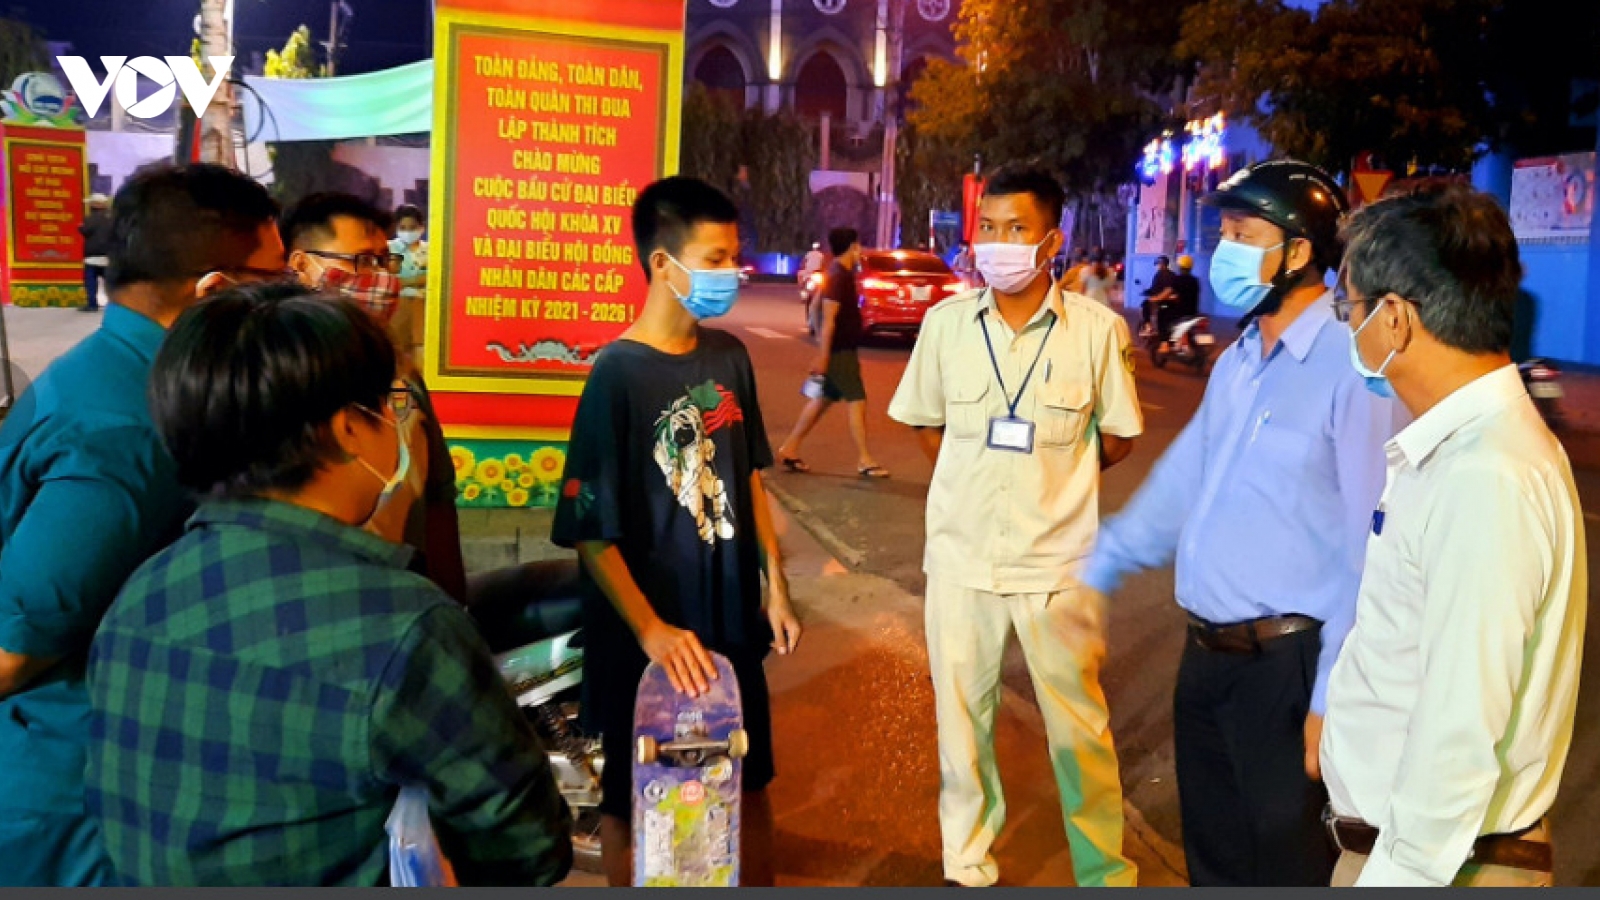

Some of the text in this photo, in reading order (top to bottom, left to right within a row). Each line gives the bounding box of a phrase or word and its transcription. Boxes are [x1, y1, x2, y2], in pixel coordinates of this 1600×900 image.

[574, 95, 598, 115] THI
[602, 215, 622, 235] XV
[544, 301, 579, 320] 2021
[591, 303, 626, 323] 2026
